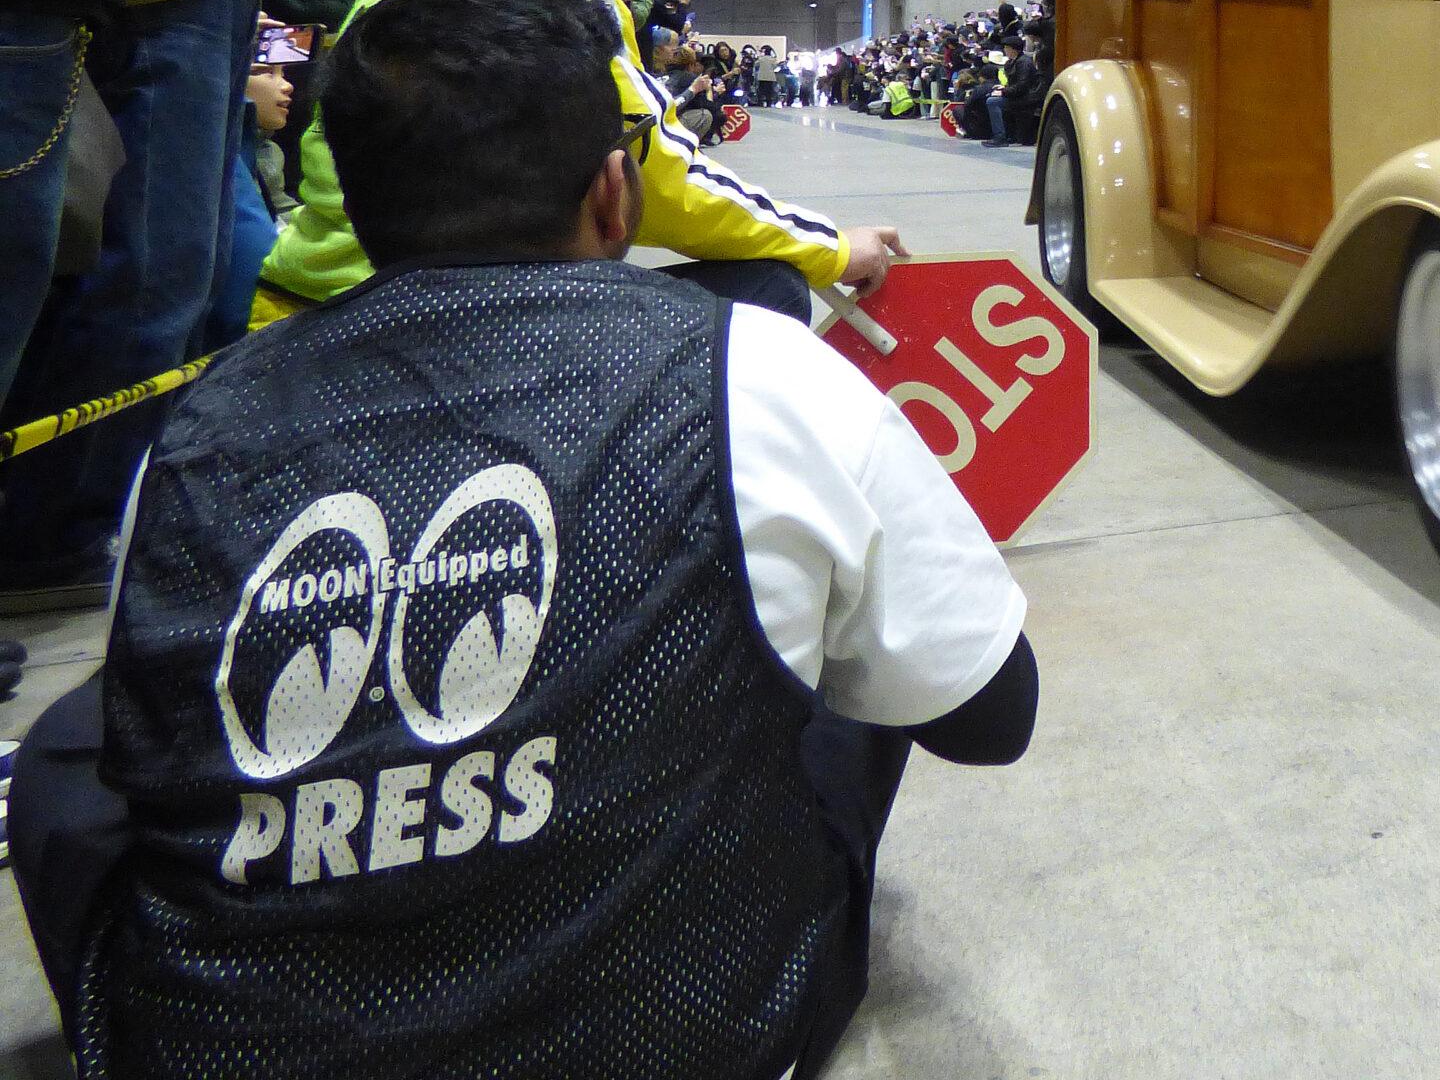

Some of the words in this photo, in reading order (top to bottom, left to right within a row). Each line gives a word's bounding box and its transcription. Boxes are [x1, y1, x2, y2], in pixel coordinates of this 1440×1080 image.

[886, 284, 1066, 474] STO
[260, 564, 370, 613] MOON
[378, 534, 529, 595] Equipped
[221, 736, 557, 885] PRESS
